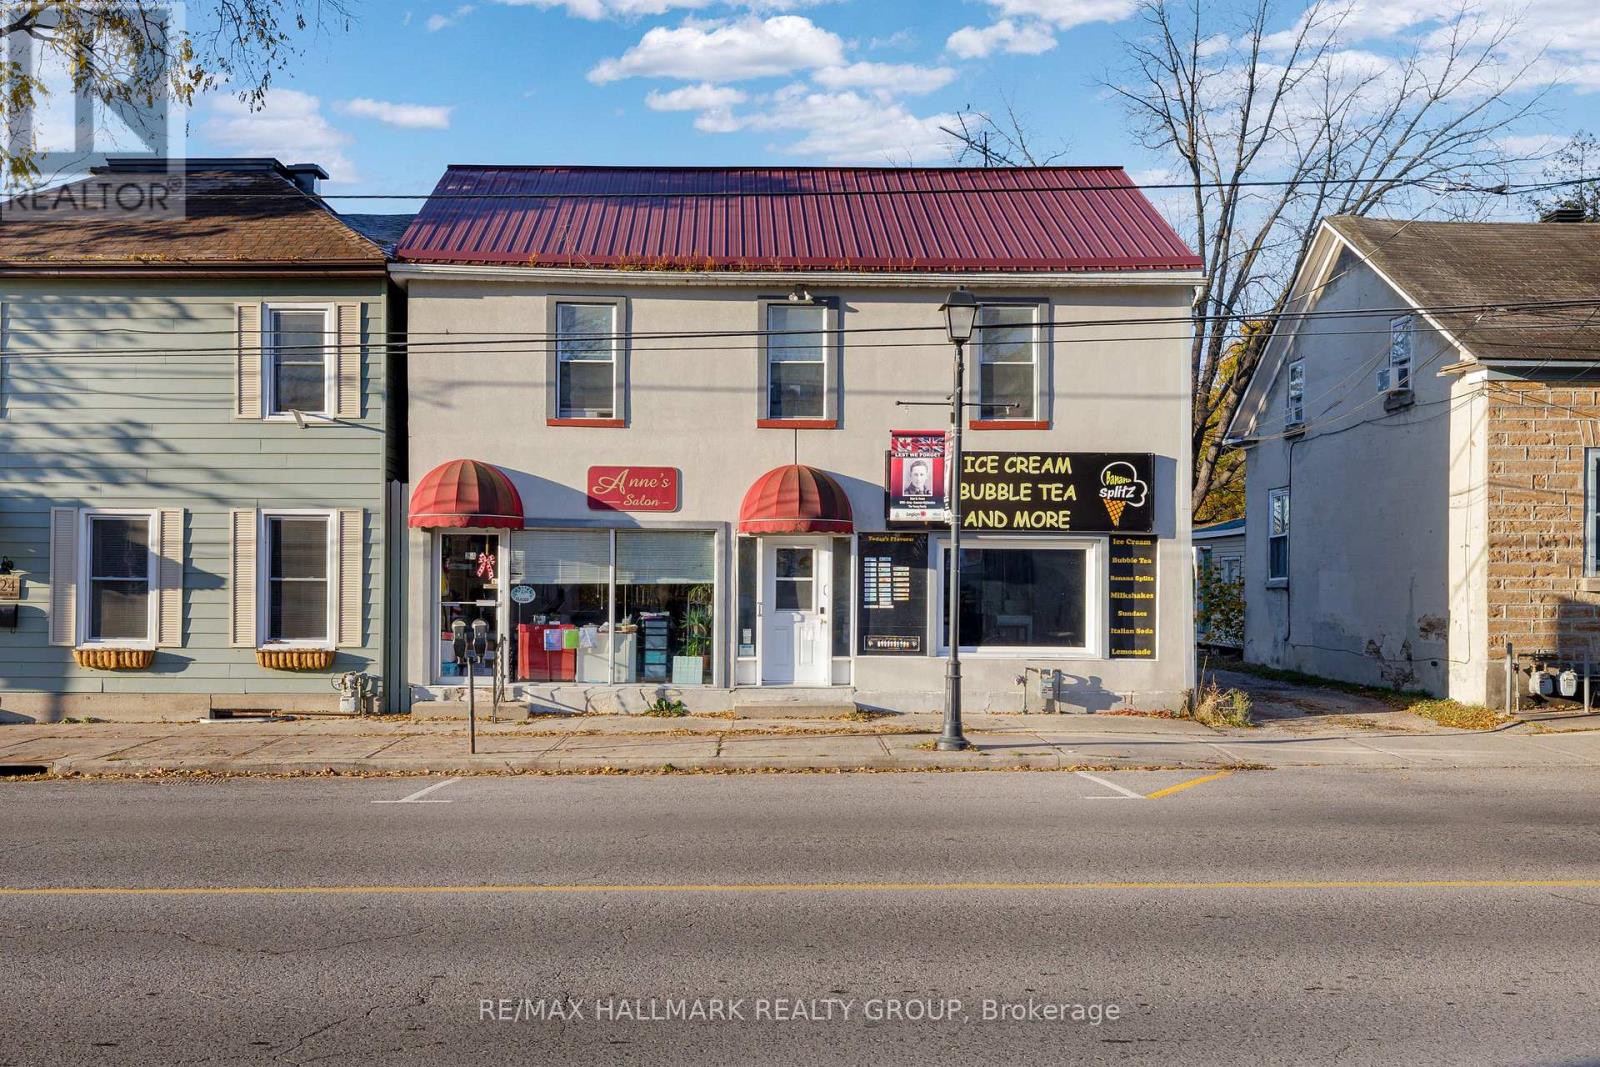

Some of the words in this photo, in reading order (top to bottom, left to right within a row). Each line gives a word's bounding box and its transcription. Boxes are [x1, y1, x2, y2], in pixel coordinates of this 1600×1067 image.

[964, 455, 999, 474] ICE
[1004, 455, 1073, 474] CREAM
[592, 468, 671, 495] Anne's
[623, 493, 659, 507] Salon
[960, 483, 1032, 501] BUBBLE
[1038, 483, 1077, 501] TEA
[964, 510, 1008, 528] AND
[1013, 510, 1071, 529] MORE
[1110, 591, 1154, 599] Milkshakes
